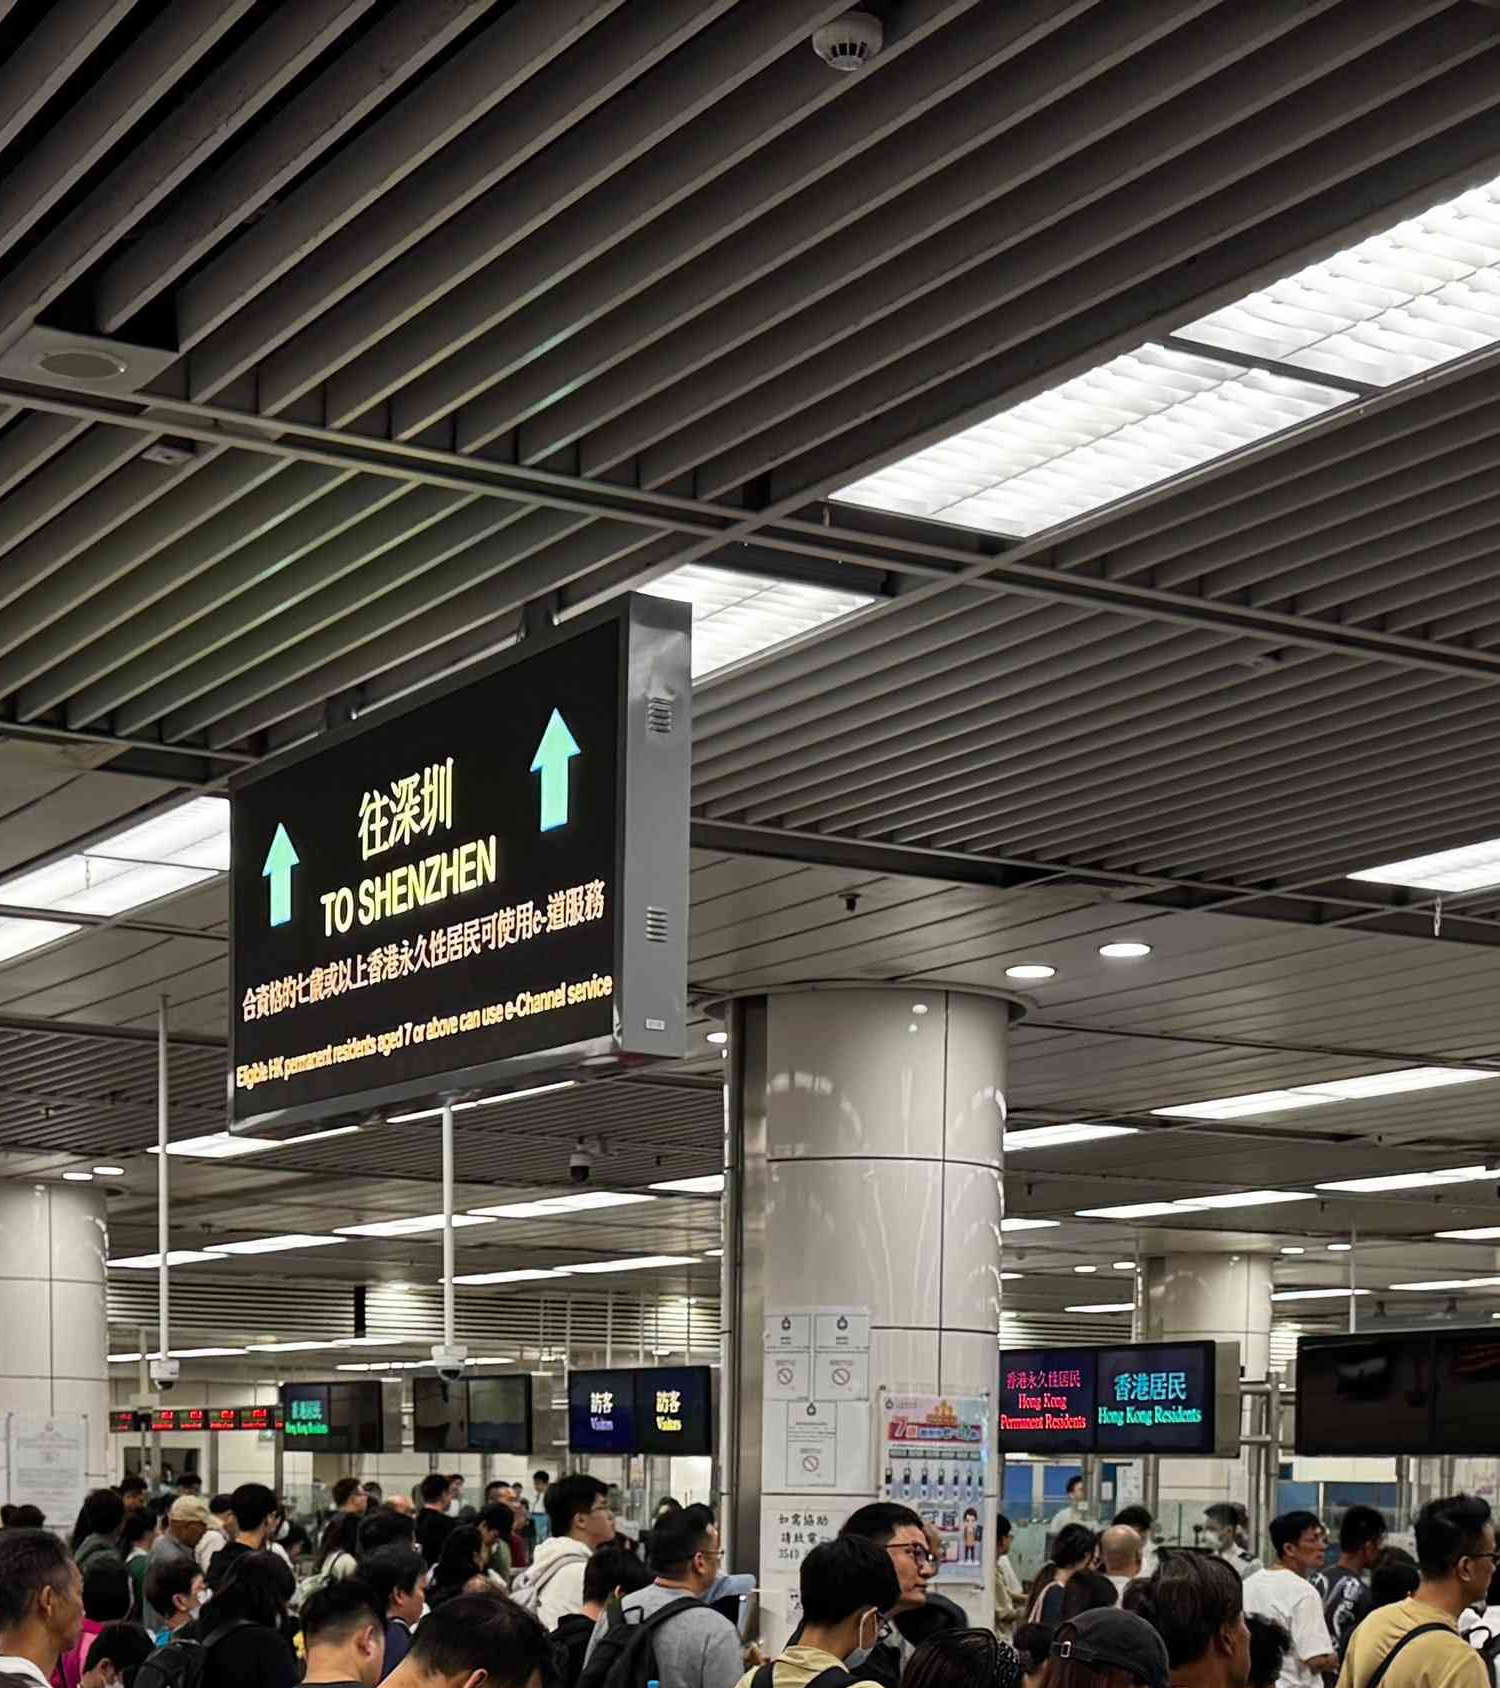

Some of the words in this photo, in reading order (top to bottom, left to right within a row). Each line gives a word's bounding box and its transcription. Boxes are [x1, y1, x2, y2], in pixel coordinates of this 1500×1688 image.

[358, 757, 453, 861] 往深圳
[320, 887, 354, 937] TO
[358, 834, 496, 925] SHENZHEN
[269, 1056, 284, 1080] HK
[333, 1034, 376, 1064] residents
[378, 1025, 403, 1056] aged
[404, 1022, 413, 1046] 7
[413, 1023, 425, 1043] or
[426, 1015, 458, 1040] above
[460, 1009, 480, 1032] can
[482, 1003, 503, 1026] use
[505, 982, 566, 1020] e-Channel
[567, 973, 613, 1004] service
[1006, 1370, 1081, 1389] 香港永久性居民
[1114, 1372, 1186, 1401] 香港居民
[1019, 1394, 1041, 1410] Hong
[1043, 1393, 1067, 1410] Kong
[1045, 1414, 1087, 1430] Residents
[1099, 1407, 1124, 1426] Hong
[1126, 1406, 1154, 1426] Kong
[1155, 1406, 1203, 1424] Residents
